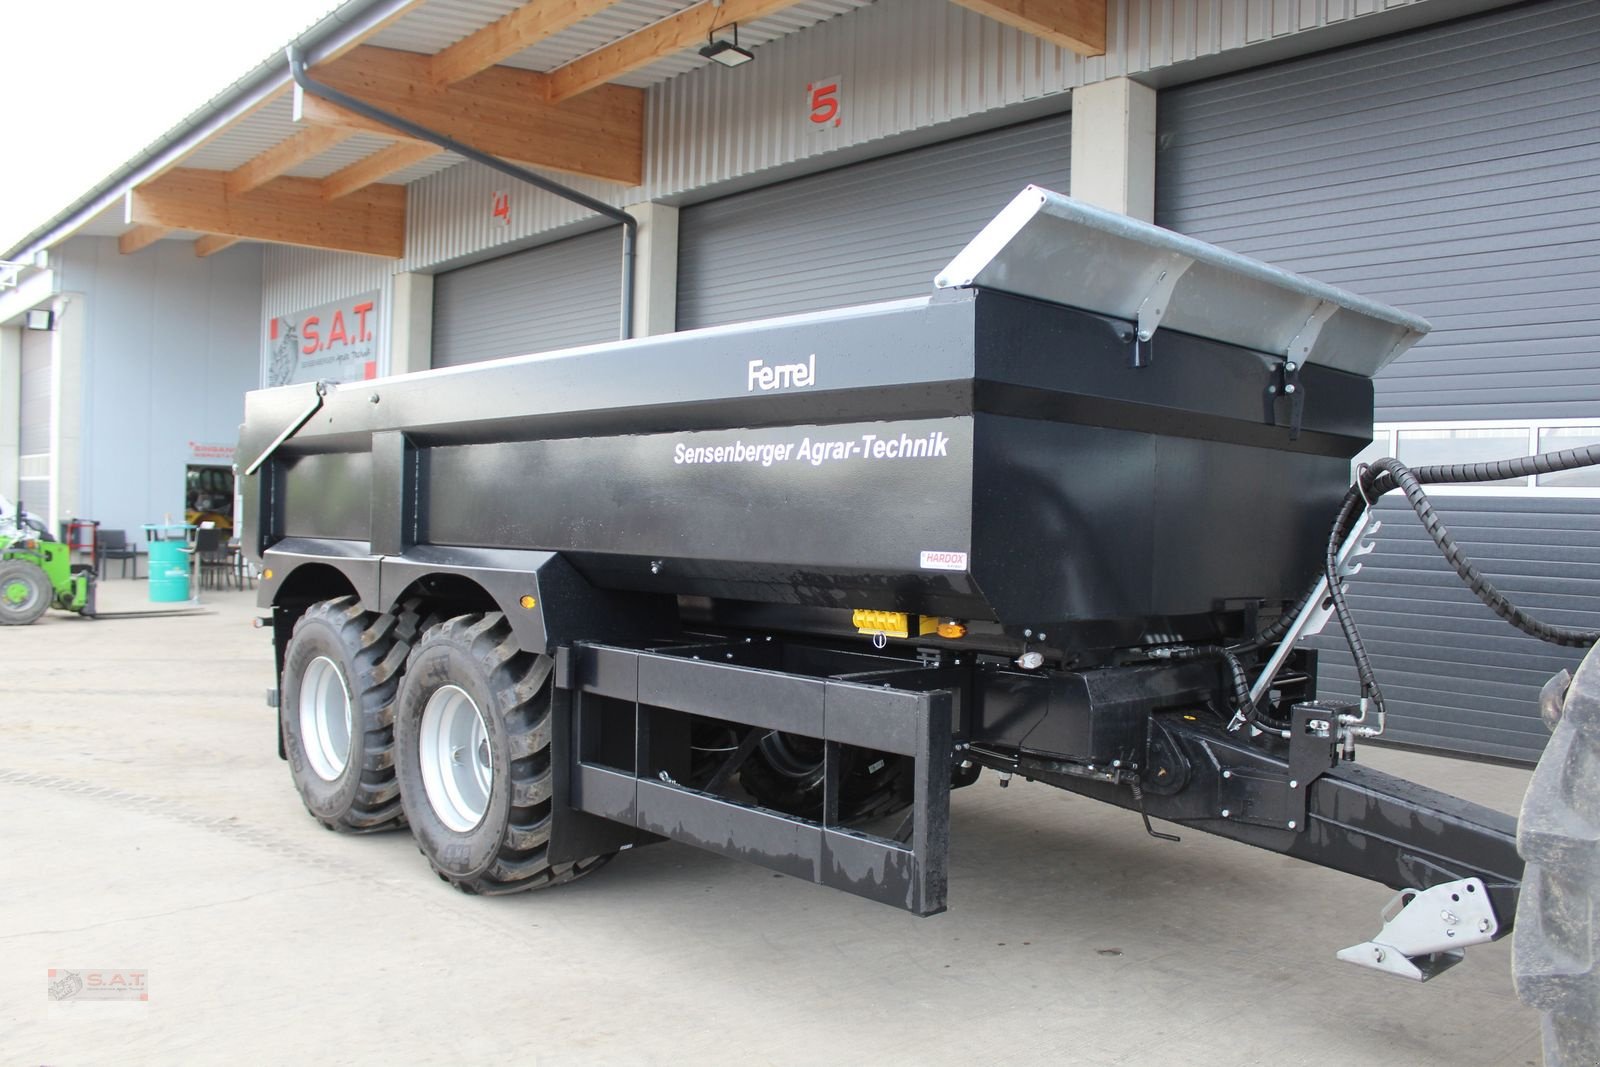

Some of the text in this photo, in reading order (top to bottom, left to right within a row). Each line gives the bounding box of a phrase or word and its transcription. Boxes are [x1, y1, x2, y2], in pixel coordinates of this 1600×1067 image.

[810, 83, 838, 123] 5
[494, 194, 509, 219] 4
[303, 301, 373, 355] S.A.T.
[748, 354, 816, 391] Ferrel
[674, 431, 950, 467] Sensenberger Agrar-Technik
[926, 553, 963, 564] HARDOX
